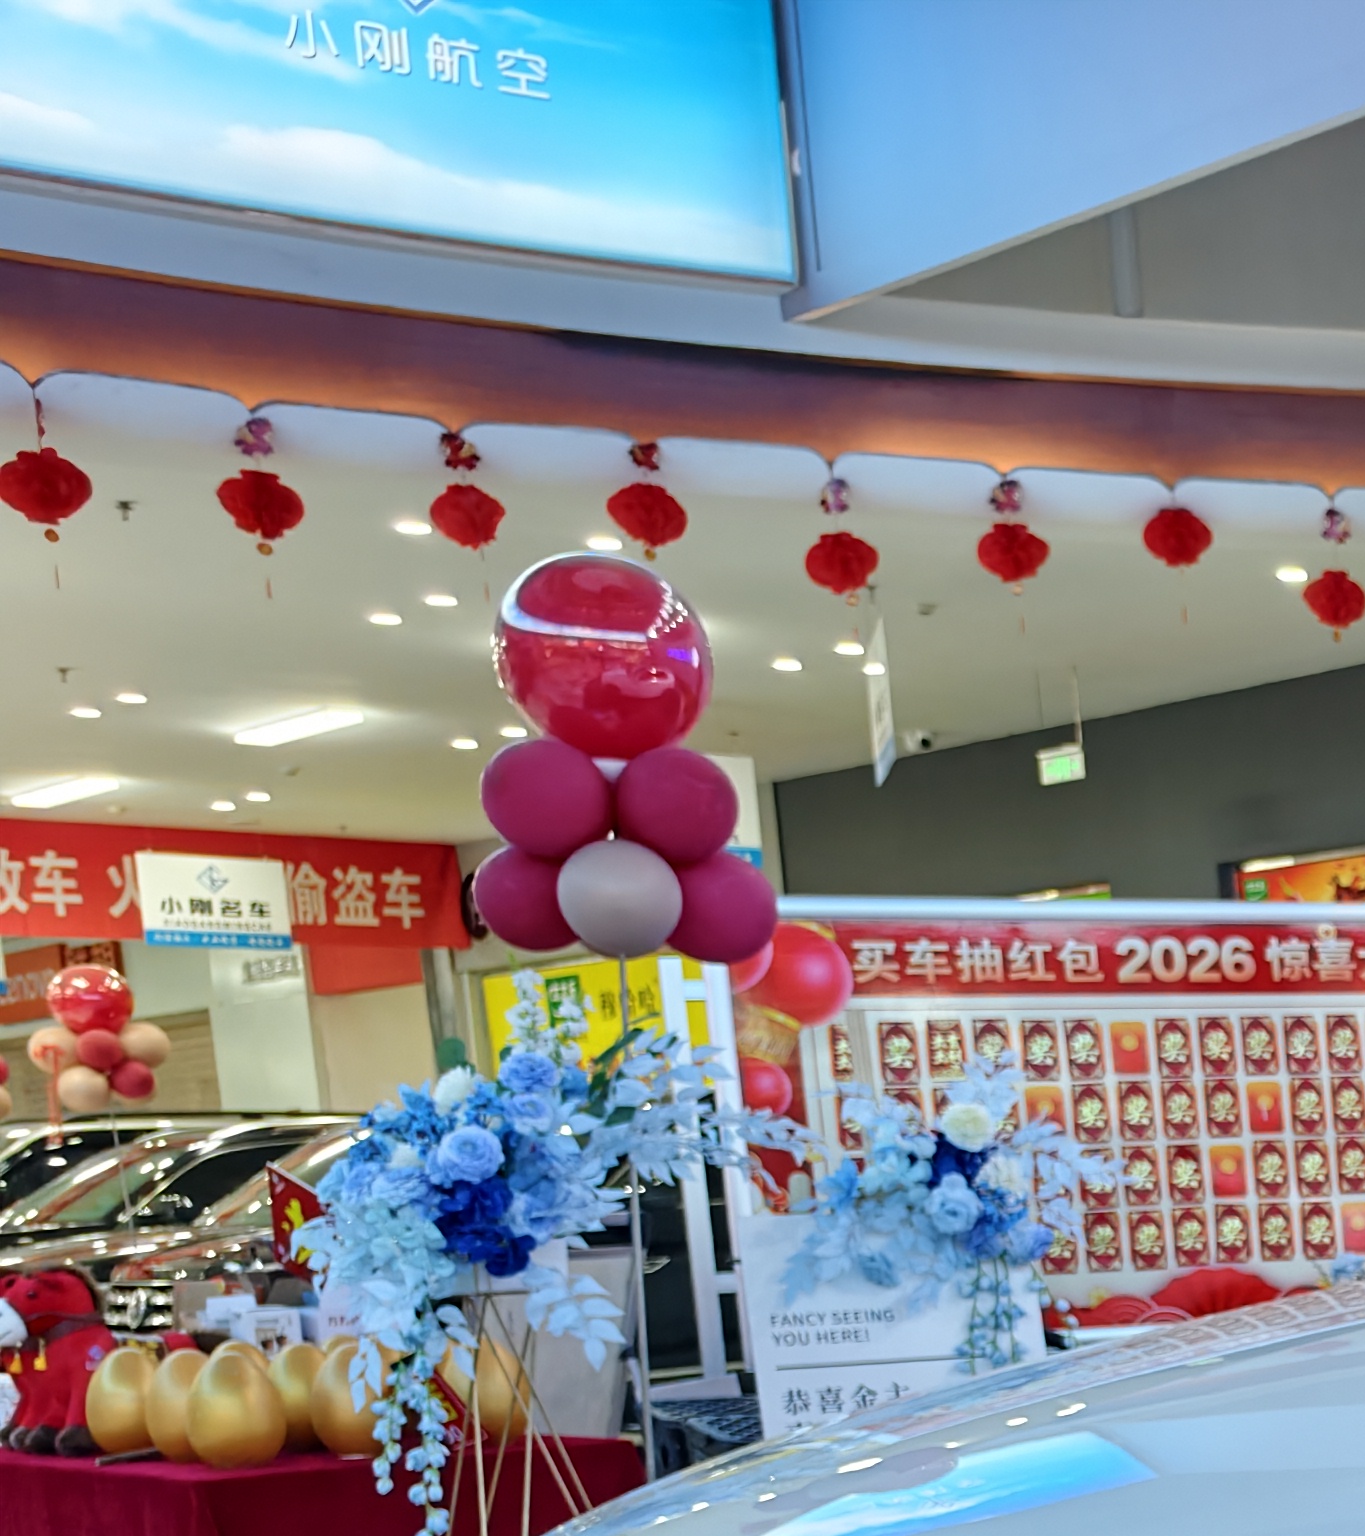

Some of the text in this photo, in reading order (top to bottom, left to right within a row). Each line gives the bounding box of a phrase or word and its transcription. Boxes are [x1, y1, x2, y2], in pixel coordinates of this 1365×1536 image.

[284, 8, 551, 101] 小刚航空
[160, 896, 272, 918] 小刚名车
[851, 938, 1106, 985] 买车抽红包
[1117, 936, 1257, 984] 2026
[770, 1308, 896, 1328] FANCY SEEING
[772, 1327, 871, 1347] YOU HERE!
